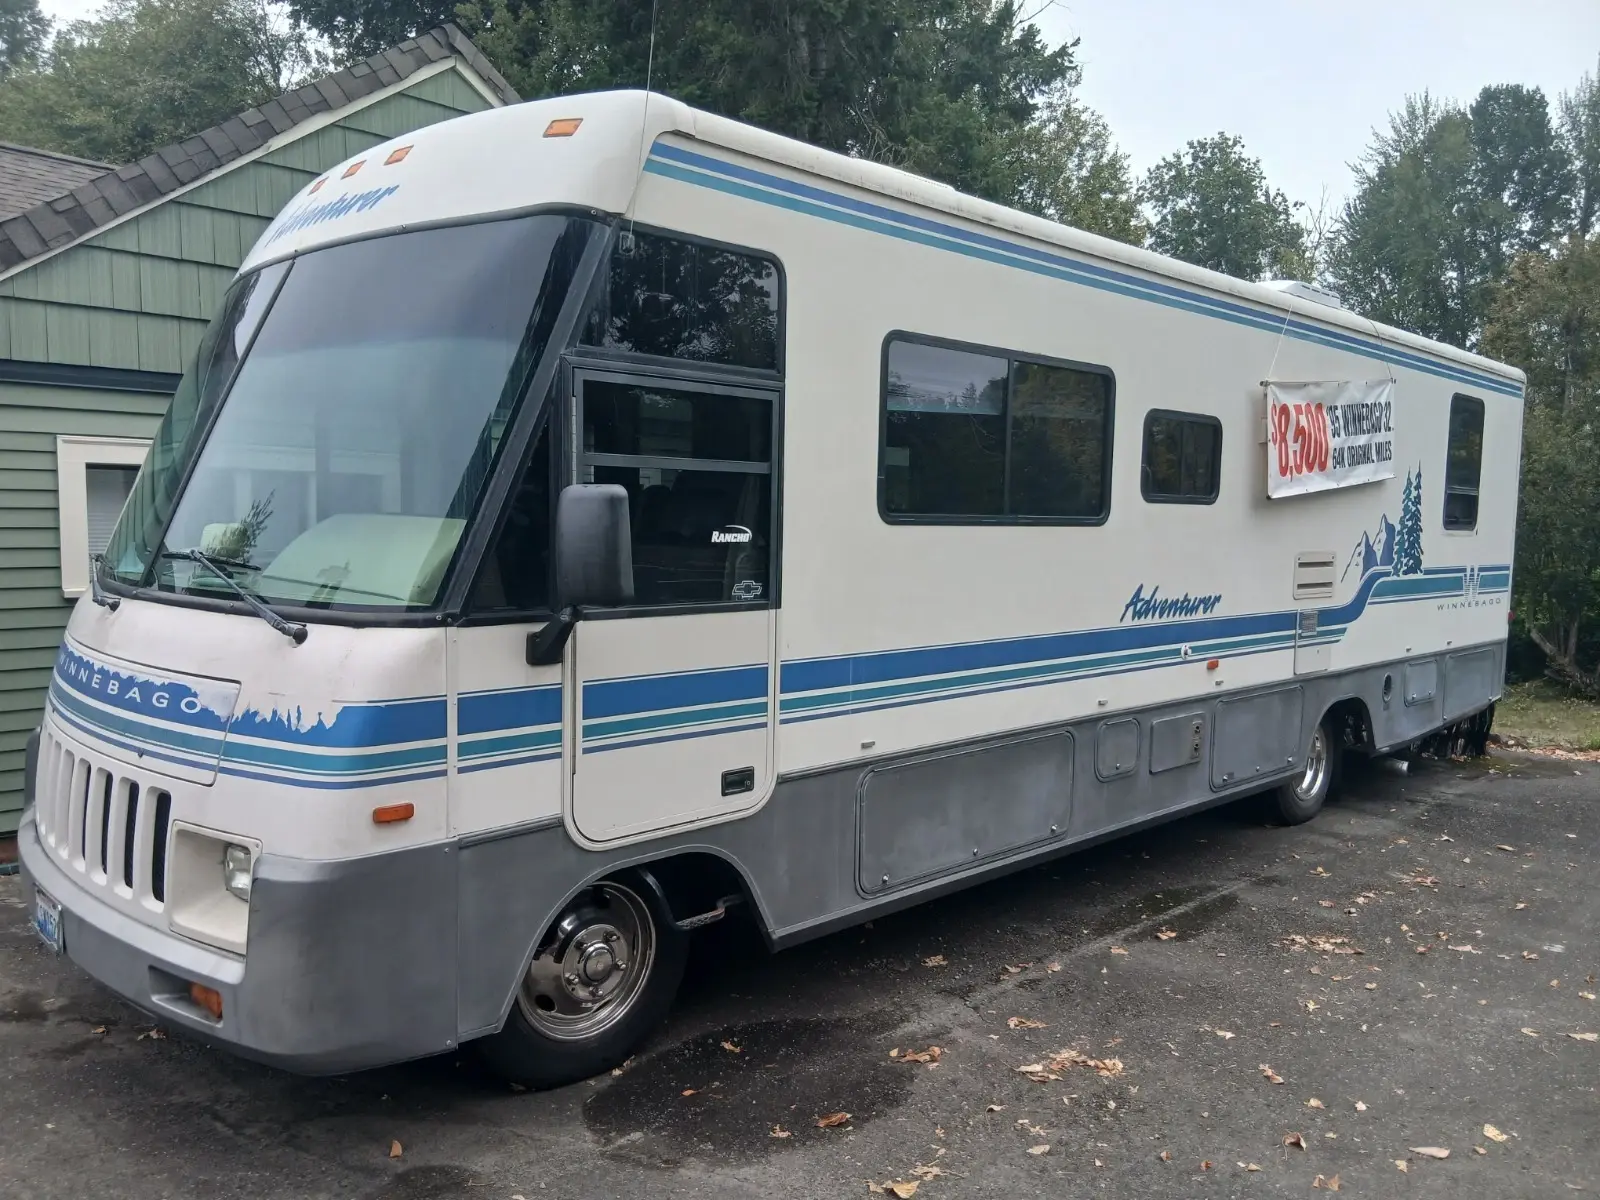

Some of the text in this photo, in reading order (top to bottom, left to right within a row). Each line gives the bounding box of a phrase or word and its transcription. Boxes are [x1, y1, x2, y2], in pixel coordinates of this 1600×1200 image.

[1341, 401, 1383, 437] WINNEBAGO
[1271, 399, 1329, 482] $8,500
[1332, 440, 1392, 469] 64K ORIGINAL MILES
[1119, 583, 1222, 623] Adventurer
[1437, 597, 1501, 611] WINNEBAGO
